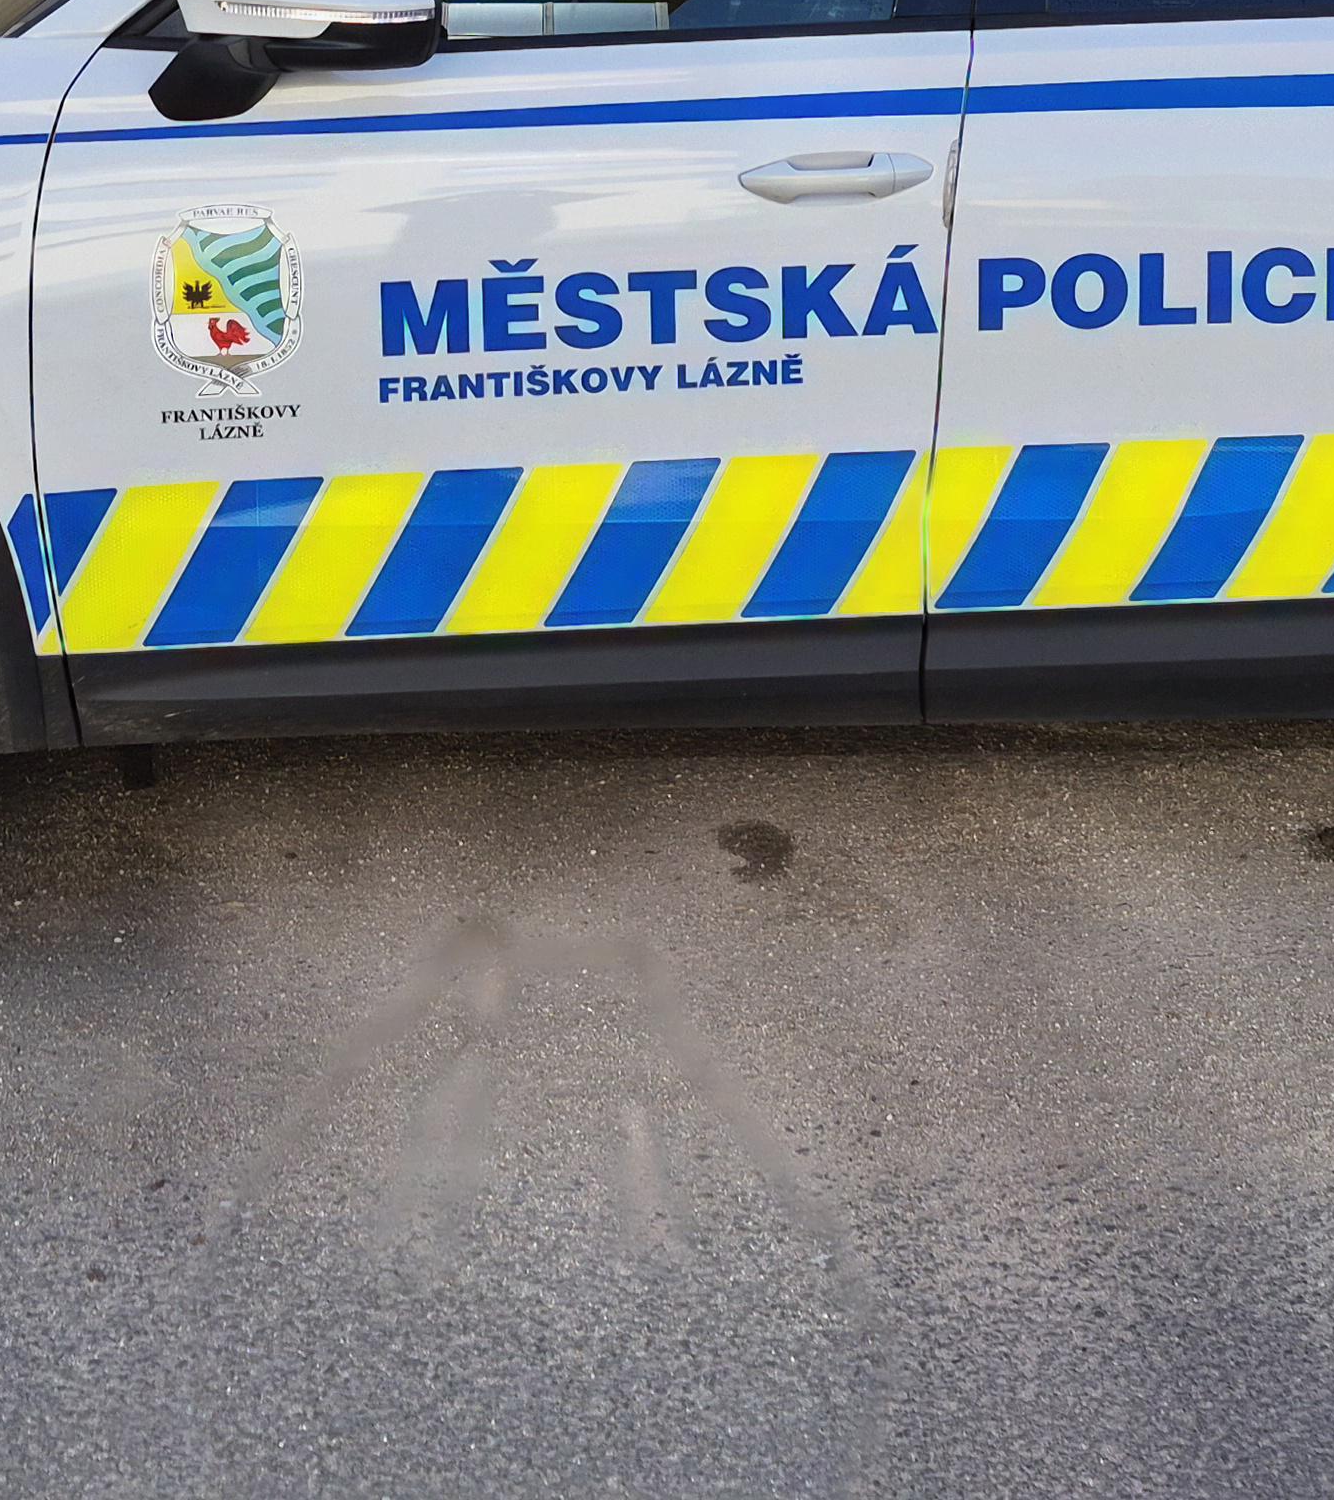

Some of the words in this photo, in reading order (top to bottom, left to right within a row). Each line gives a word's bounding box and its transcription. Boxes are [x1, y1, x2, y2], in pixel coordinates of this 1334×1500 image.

[154, 250, 166, 313] CONCORDIA
[380, 244, 939, 357] MĚSTSKÁ
[156, 327, 208, 374] FRANTIŠKOVY
[379, 364, 662, 403] FRANTIŠKOVY
[677, 353, 804, 389] LÁZNĚ
[161, 402, 301, 424] FRANTIŠKOVY
[198, 421, 264, 441] LÁZNĚ
